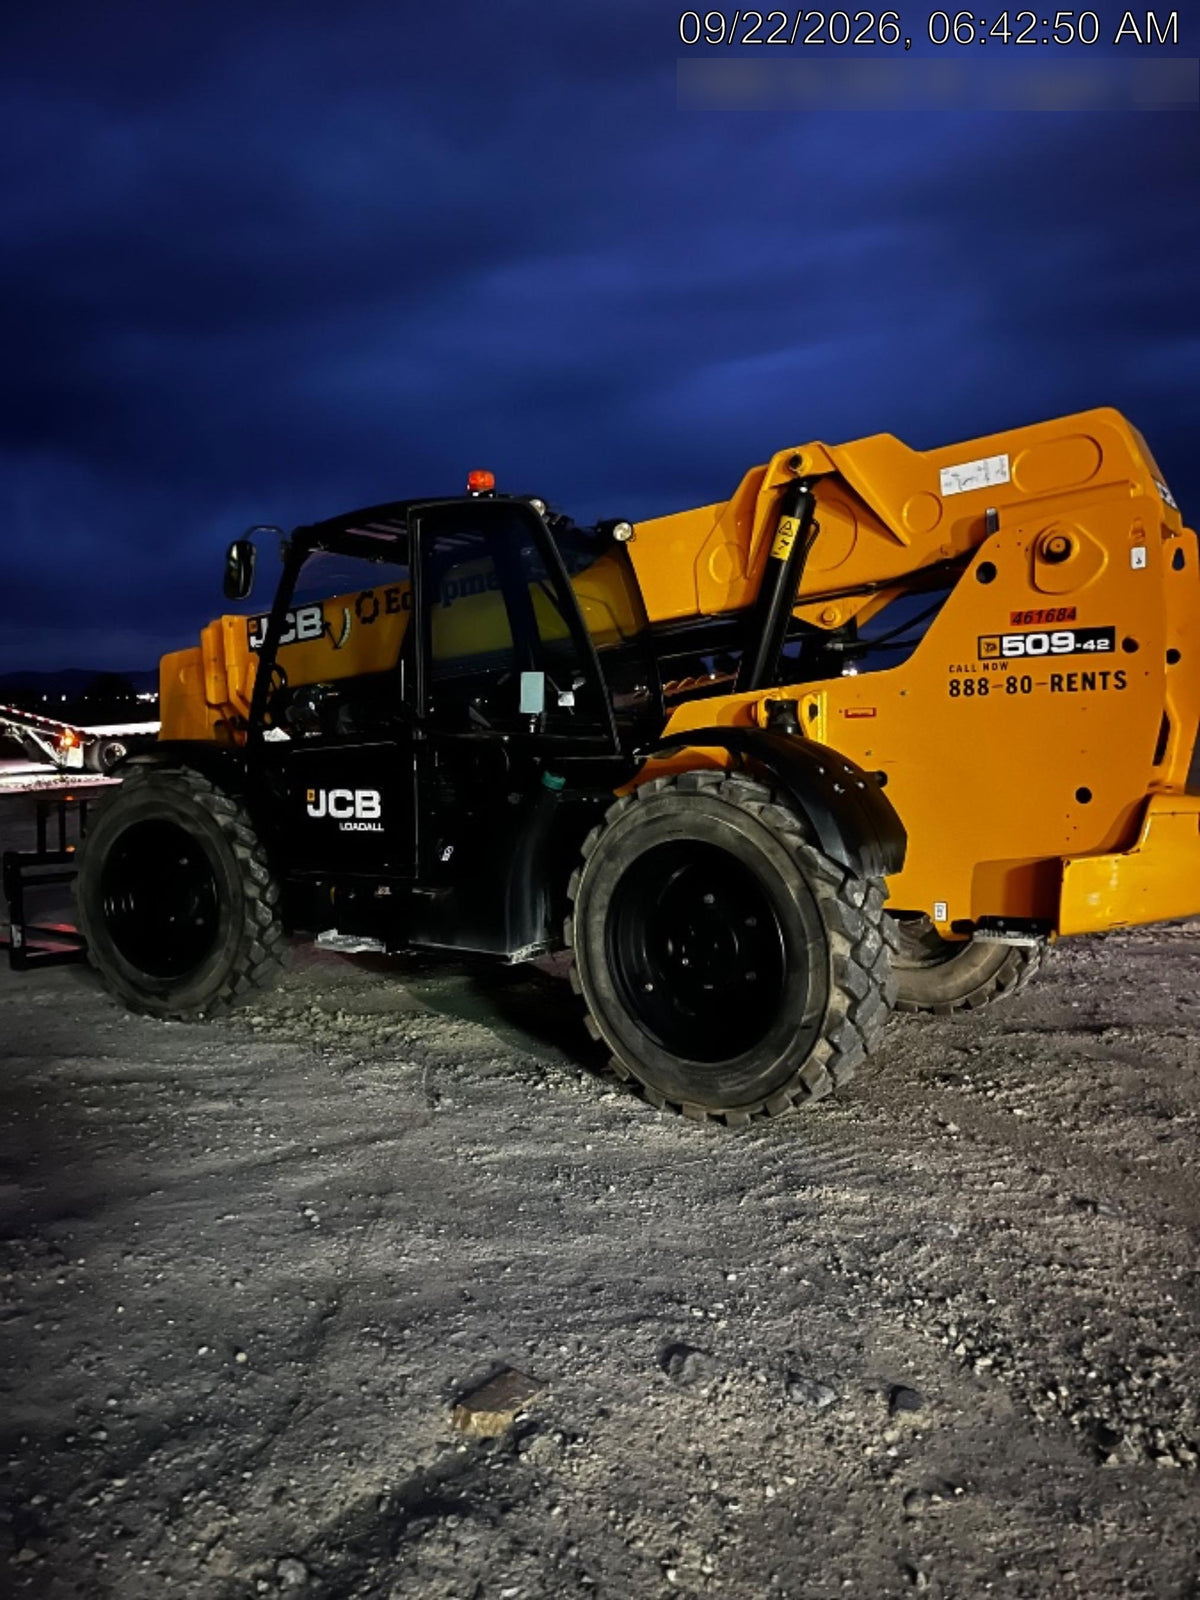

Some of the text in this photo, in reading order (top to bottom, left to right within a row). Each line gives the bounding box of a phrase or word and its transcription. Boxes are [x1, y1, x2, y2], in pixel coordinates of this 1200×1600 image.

[1012, 608, 1077, 624] 461684
[249, 606, 323, 649] JCB
[1002, 631, 1110, 656] 509-42
[949, 662, 1008, 673] CALL NOW
[307, 789, 381, 818] JCB
[339, 822, 384, 832] LOADALL
